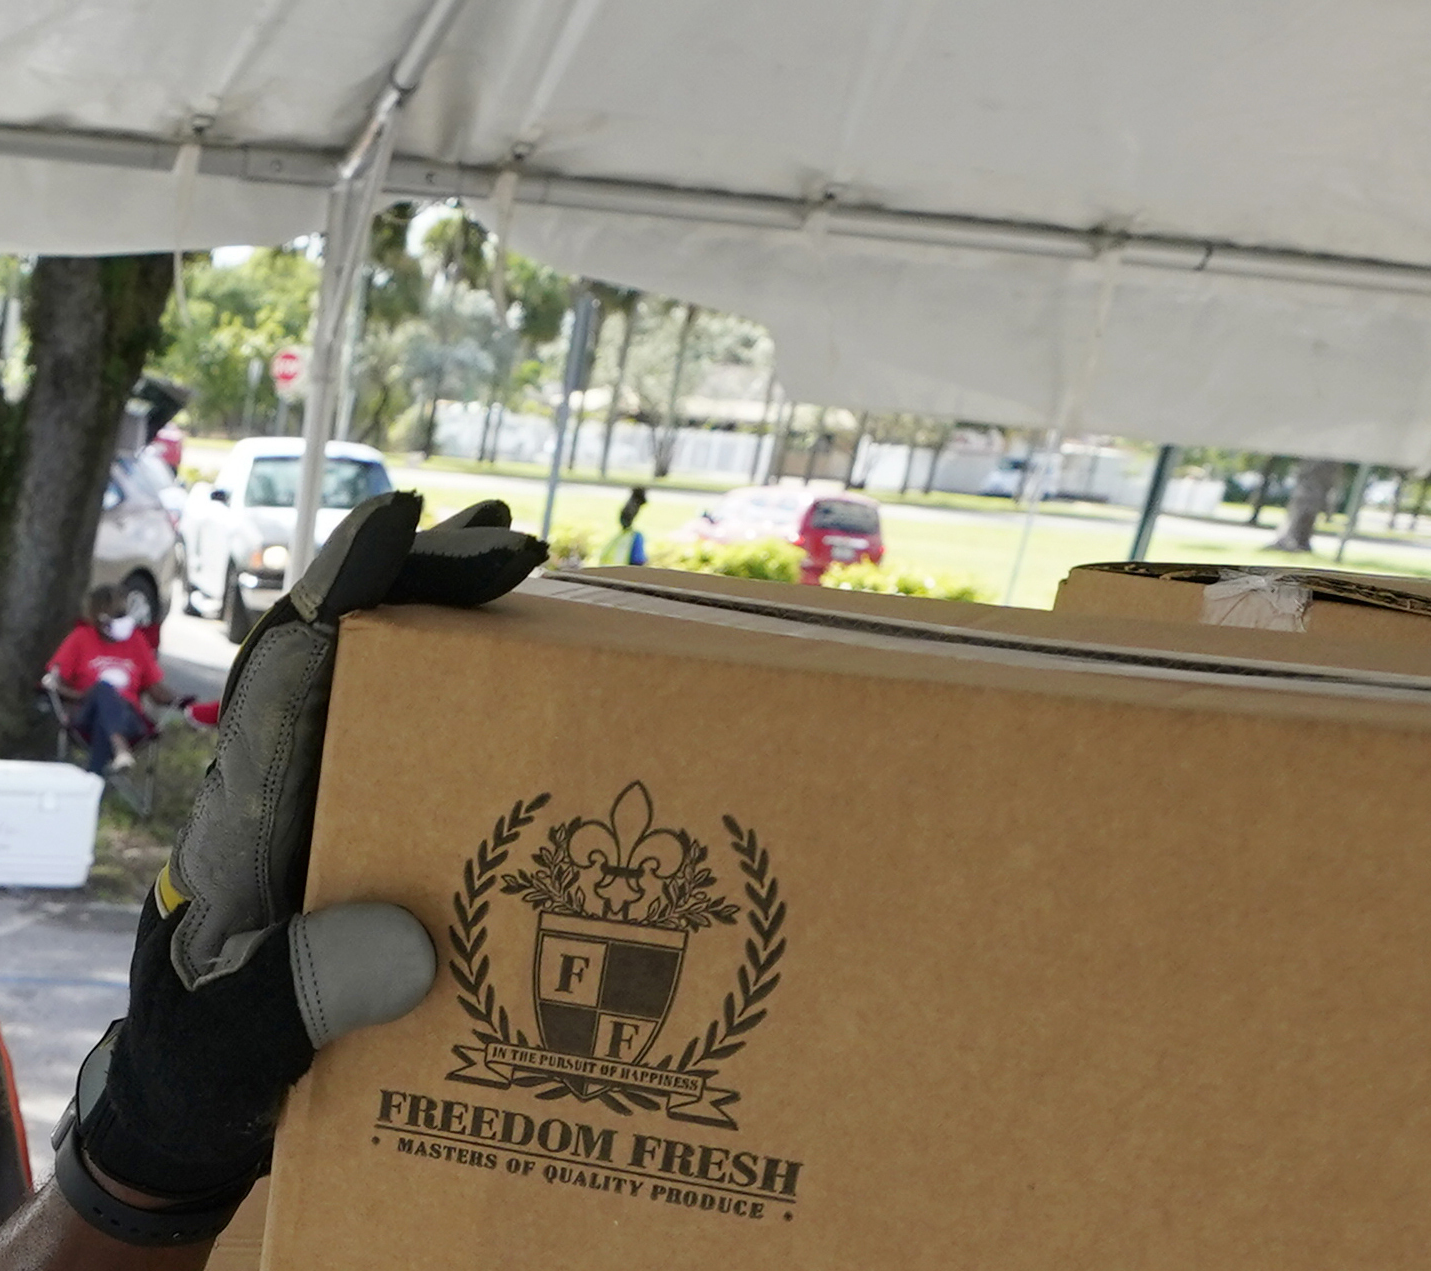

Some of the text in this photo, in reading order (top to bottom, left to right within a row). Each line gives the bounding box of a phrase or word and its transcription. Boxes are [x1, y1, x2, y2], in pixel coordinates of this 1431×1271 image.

[555, 953, 590, 995] F
[606, 1020, 639, 1059] F
[492, 1045, 699, 1092] IN THE PURSUIT OF HAPPINESS
[376, 1088, 804, 1197] FREEDOM FRESH
[398, 1137, 764, 1220] MASTERS OF QUALITY PRODUCE
